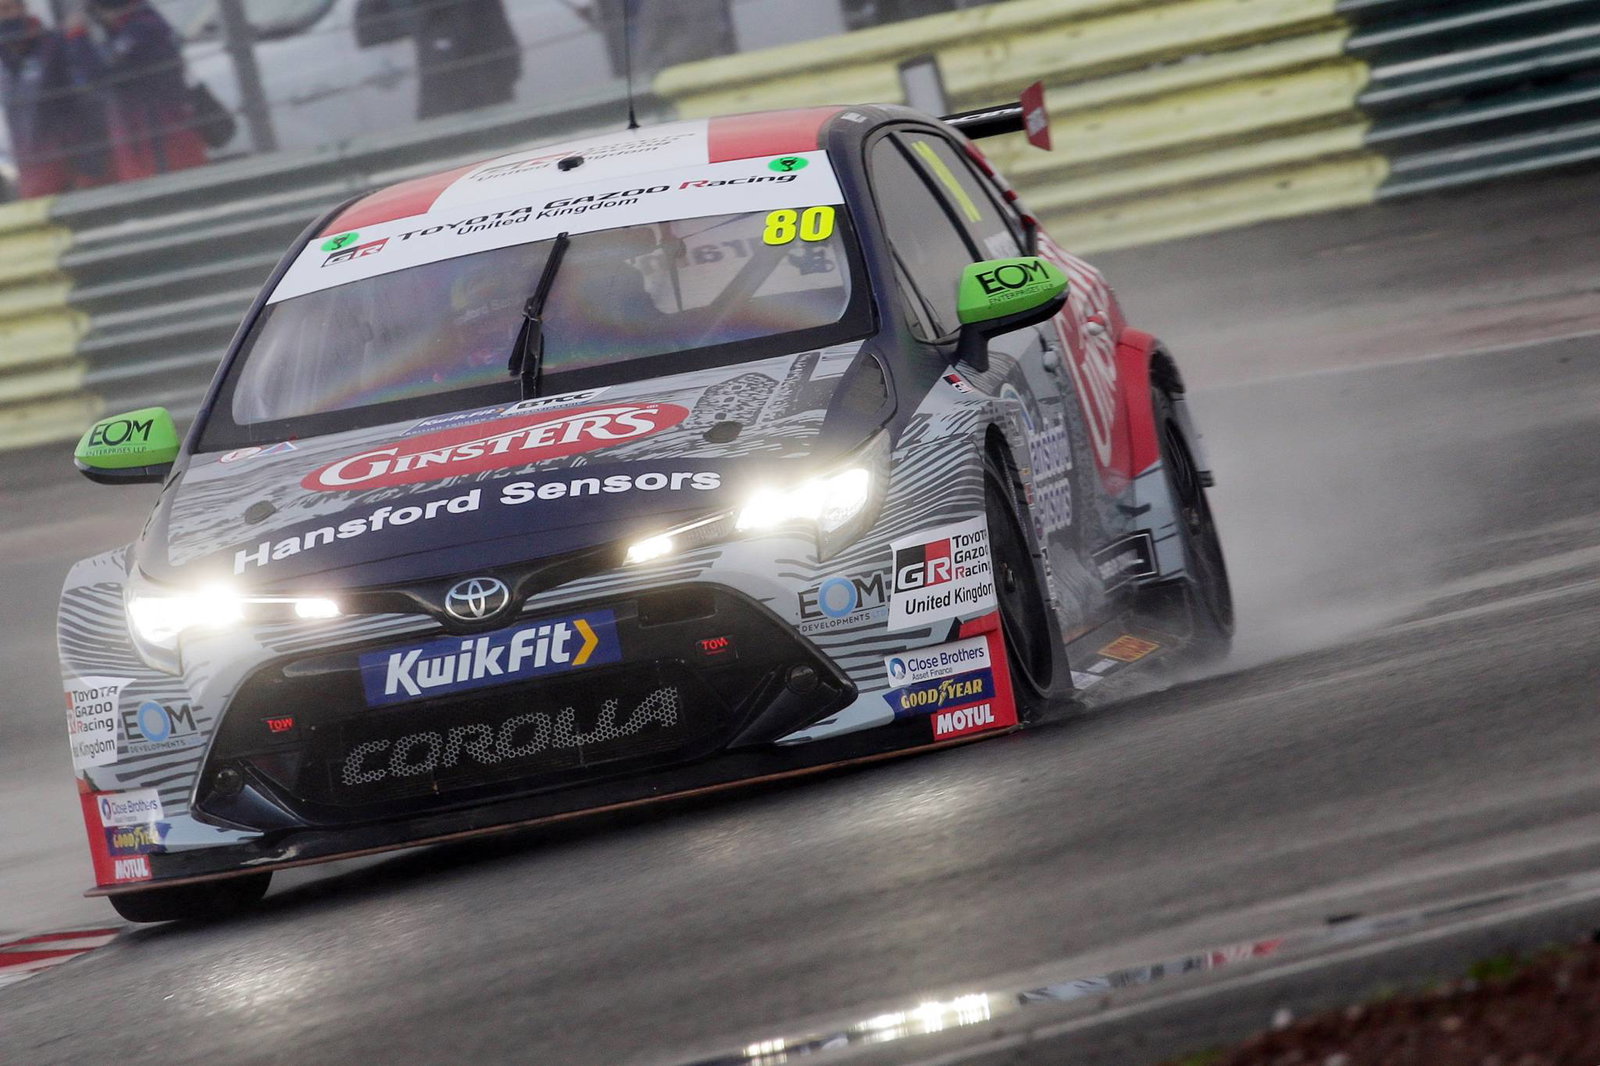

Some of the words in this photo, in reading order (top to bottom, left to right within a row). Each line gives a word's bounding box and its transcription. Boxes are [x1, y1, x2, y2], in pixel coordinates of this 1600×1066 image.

[398, 206, 532, 240] TOYOTA
[544, 185, 670, 210] GAZOO
[679, 174, 798, 190] Racing
[457, 214, 527, 235] United
[536, 197, 638, 220] Kingdom
[762, 206, 836, 246] 80
[975, 260, 1049, 294] EOM
[88, 419, 153, 447] EOM
[319, 408, 659, 485] GINSTERS
[233, 488, 481, 575] Hansford
[500, 471, 721, 505] Sensors
[897, 556, 951, 590] GR
[798, 573, 885, 619] EOM
[905, 591, 950, 615] United
[802, 613, 870, 632] DEVELOPMENTS
[702, 637, 728, 650] TOW
[908, 656, 938, 672] Close
[940, 648, 985, 665] Brothers
[912, 669, 929, 681] Asset
[930, 666, 953, 677] Finance
[72, 686, 119, 702] TOYOTA
[901, 679, 982, 708] GOODYEAR
[75, 701, 112, 718] GAZOO
[122, 700, 197, 742] EOM
[267, 717, 293, 730] TOW
[937, 703, 994, 735] MOTUL
[77, 718, 114, 733] Racing
[342, 686, 678, 786] COROLLA
[128, 800, 157, 813] Brothers
[113, 827, 158, 849] GOODY
[115, 857, 149, 879] MOTUL
